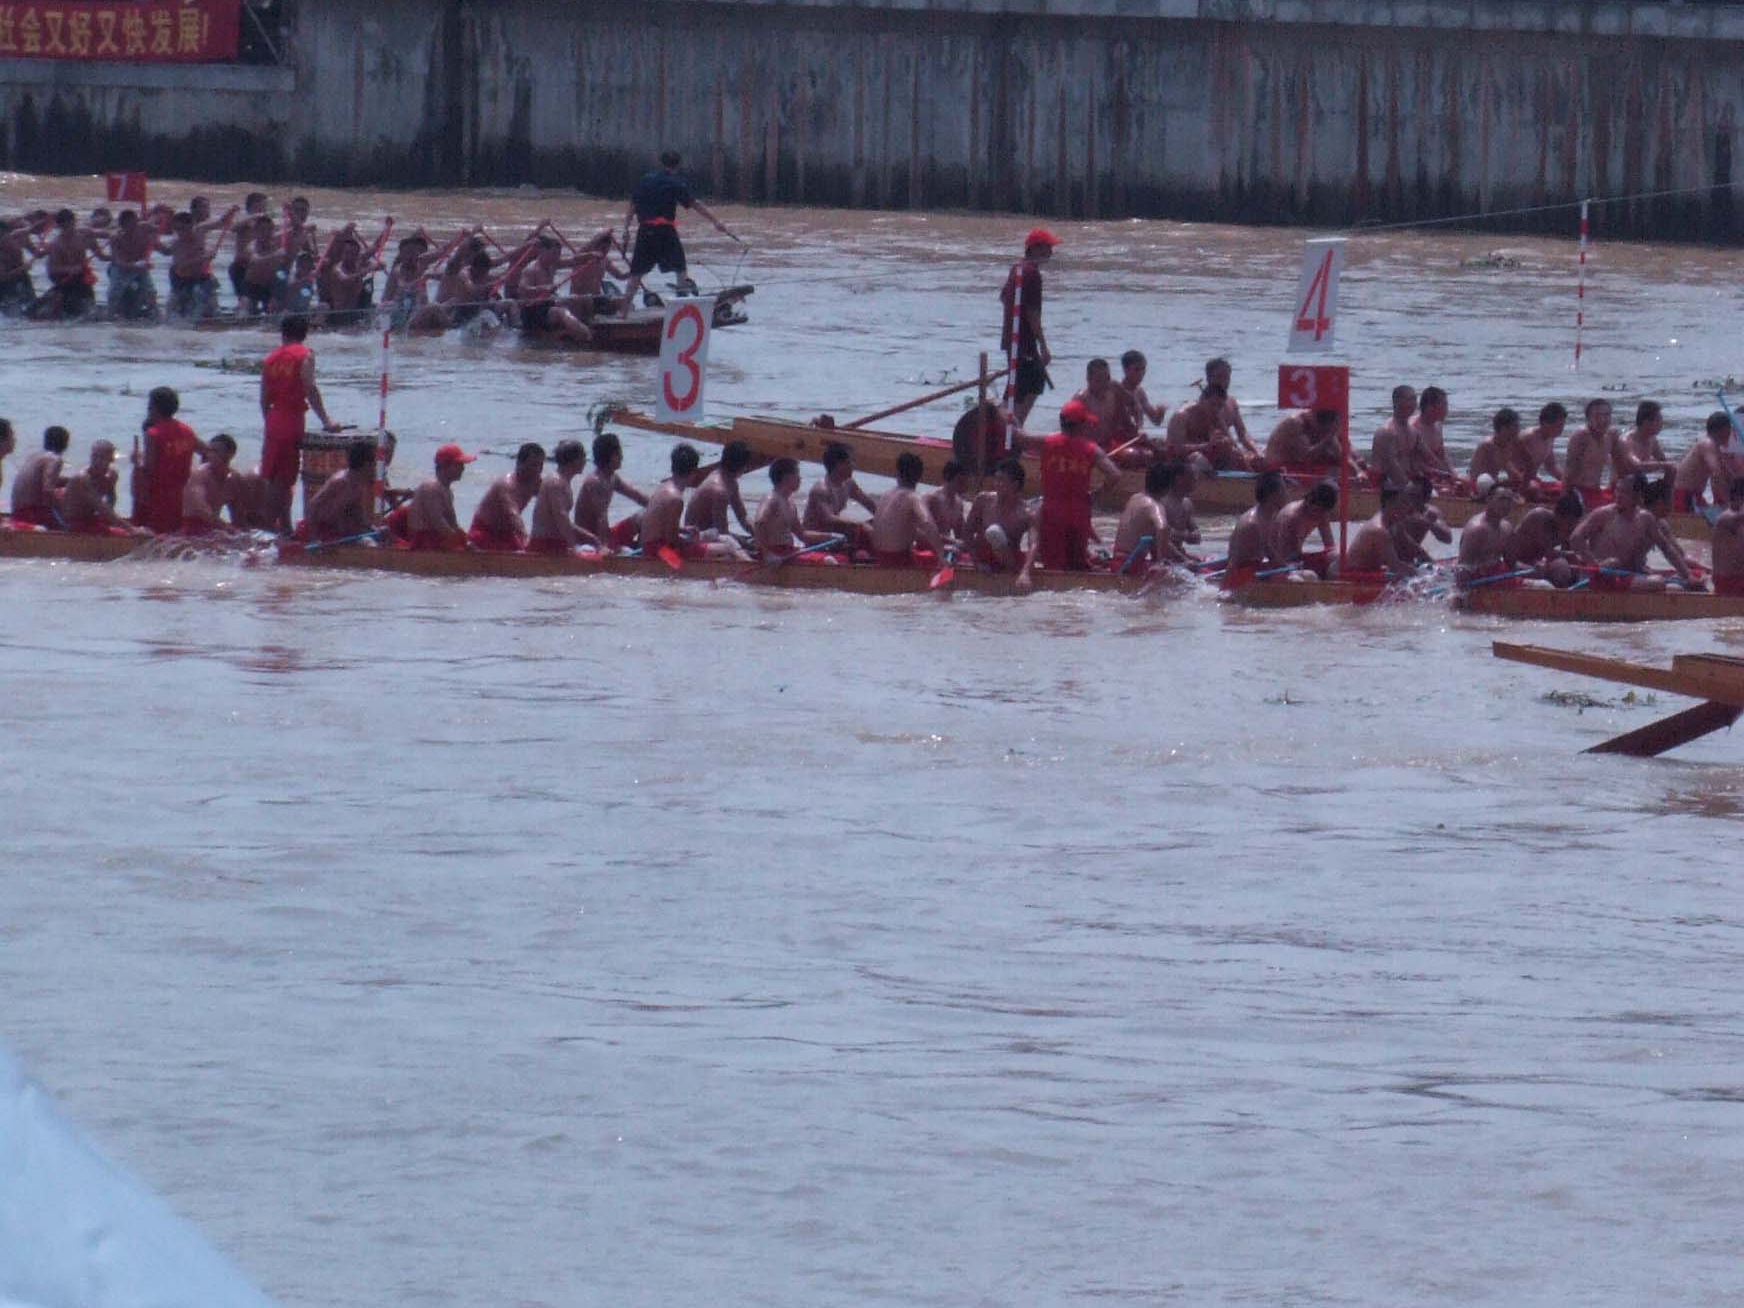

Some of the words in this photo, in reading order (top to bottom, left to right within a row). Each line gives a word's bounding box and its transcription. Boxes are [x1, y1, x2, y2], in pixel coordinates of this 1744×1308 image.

[113, 173, 129, 201] 7
[1296, 248, 1333, 340] 4
[662, 302, 706, 412] 3
[1290, 367, 1318, 407] 3
